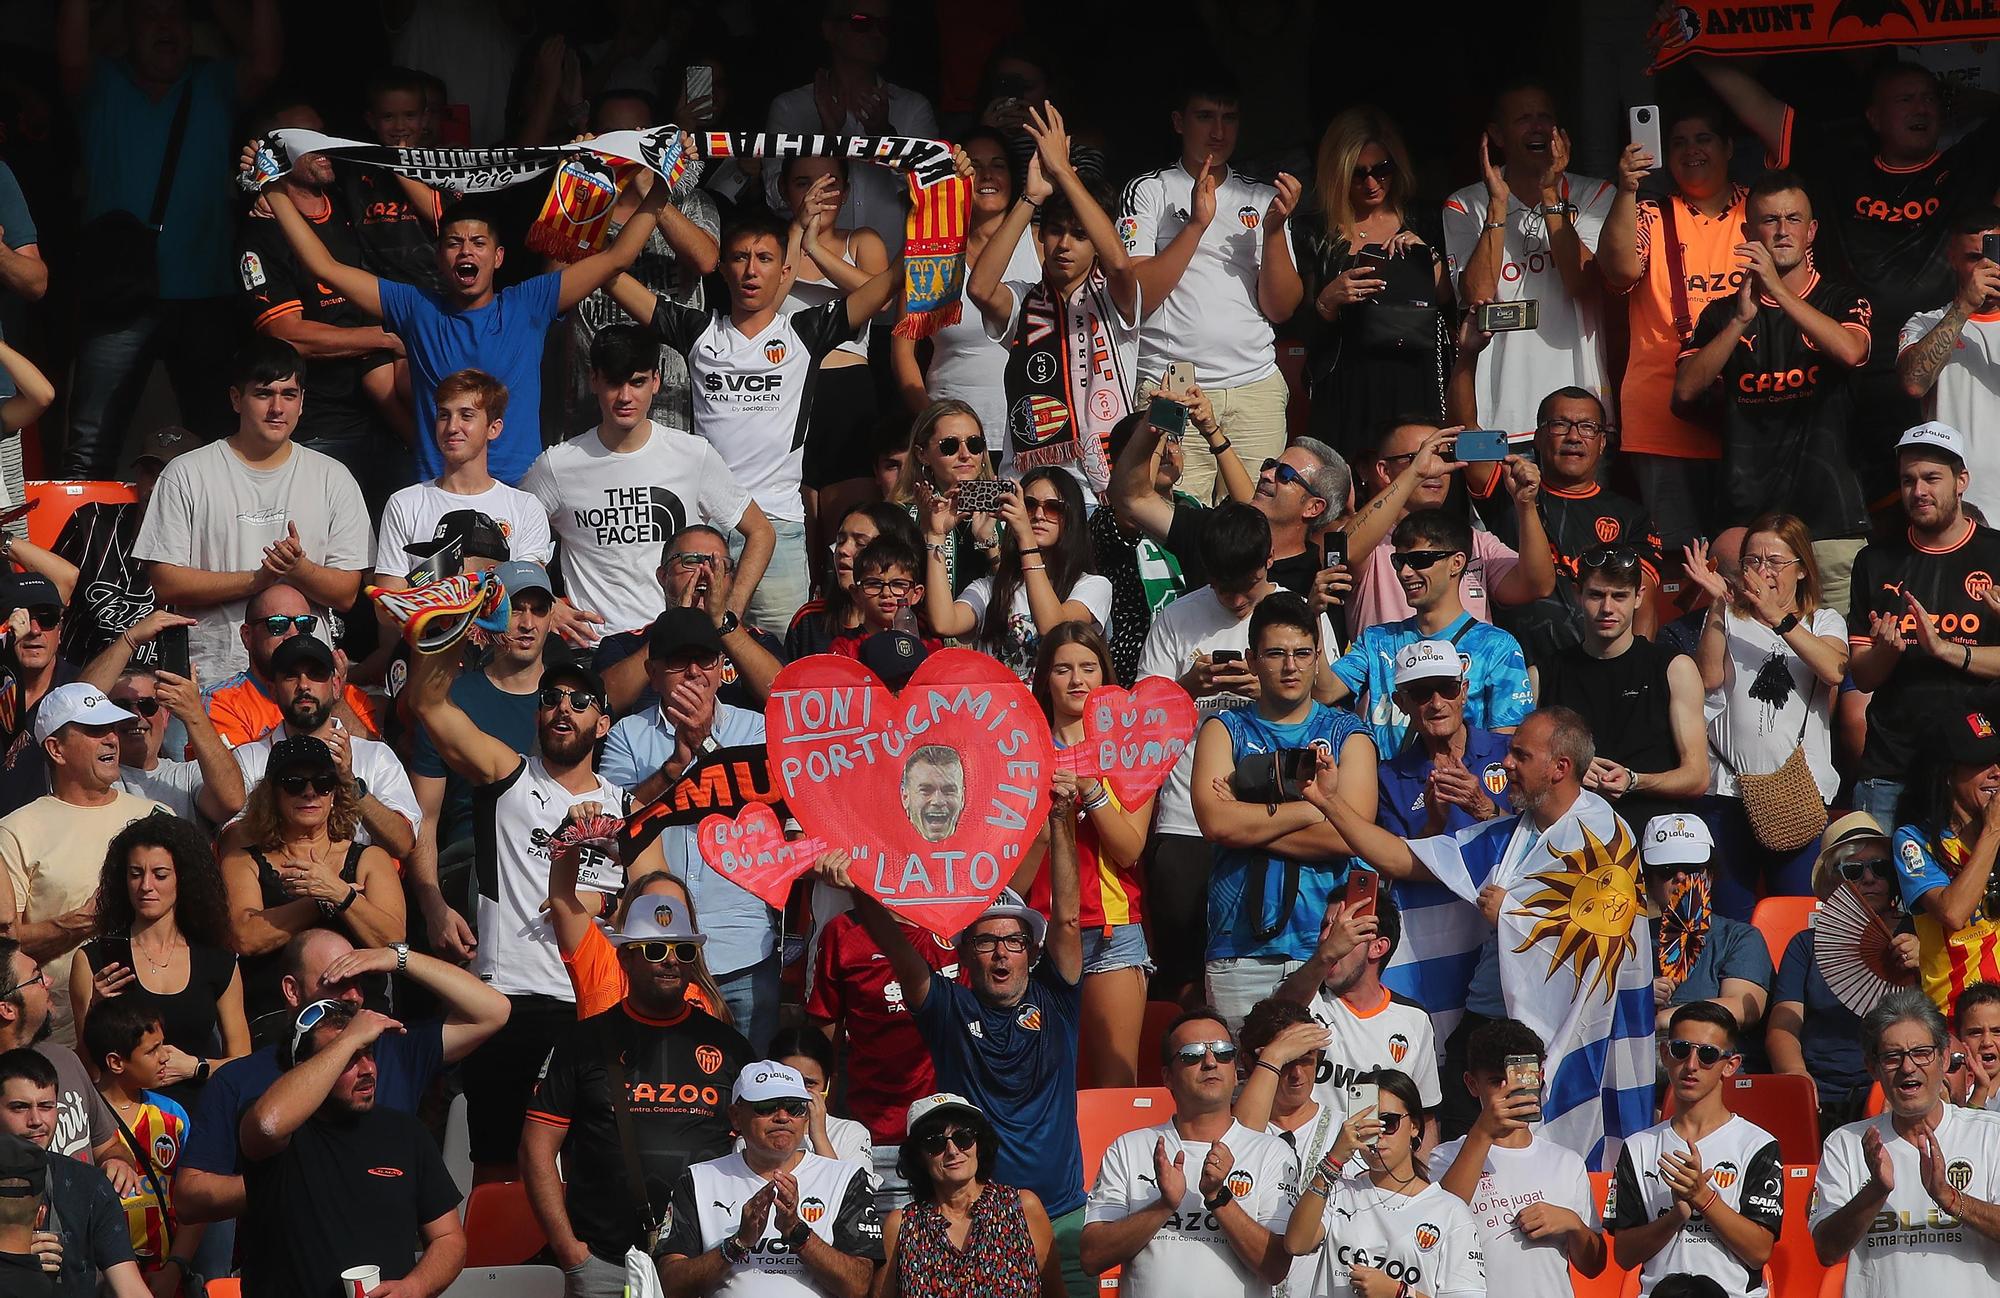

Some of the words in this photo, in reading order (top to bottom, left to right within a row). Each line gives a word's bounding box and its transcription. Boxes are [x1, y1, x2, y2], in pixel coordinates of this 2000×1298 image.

[1707, 5, 1815, 35] AMUNT
[465, 171, 515, 188] 1919
[566, 167, 597, 184] VALENCIA
[1856, 195, 1940, 223] CAZOO
[705, 372, 783, 393] $VCF
[704, 394, 729, 403] FAN
[734, 394, 781, 403] TOKEN
[1925, 428, 1951, 441] LaLiga
[604, 486, 648, 507] THE
[574, 506, 651, 529] NORTH
[596, 524, 651, 546] FACE
[1418, 652, 1444, 663] LaLiga
[1669, 829, 1695, 840] LaLiga
[887, 1003, 906, 1013] FA
[770, 1072, 794, 1082] LaLiga
[1471, 1201, 1487, 1215] Jo
[1490, 1196, 1508, 1209] he
[1508, 1189, 1545, 1209] jugat
[1485, 1215, 1499, 1229] el
[1867, 1230, 1963, 1247] smartphones
